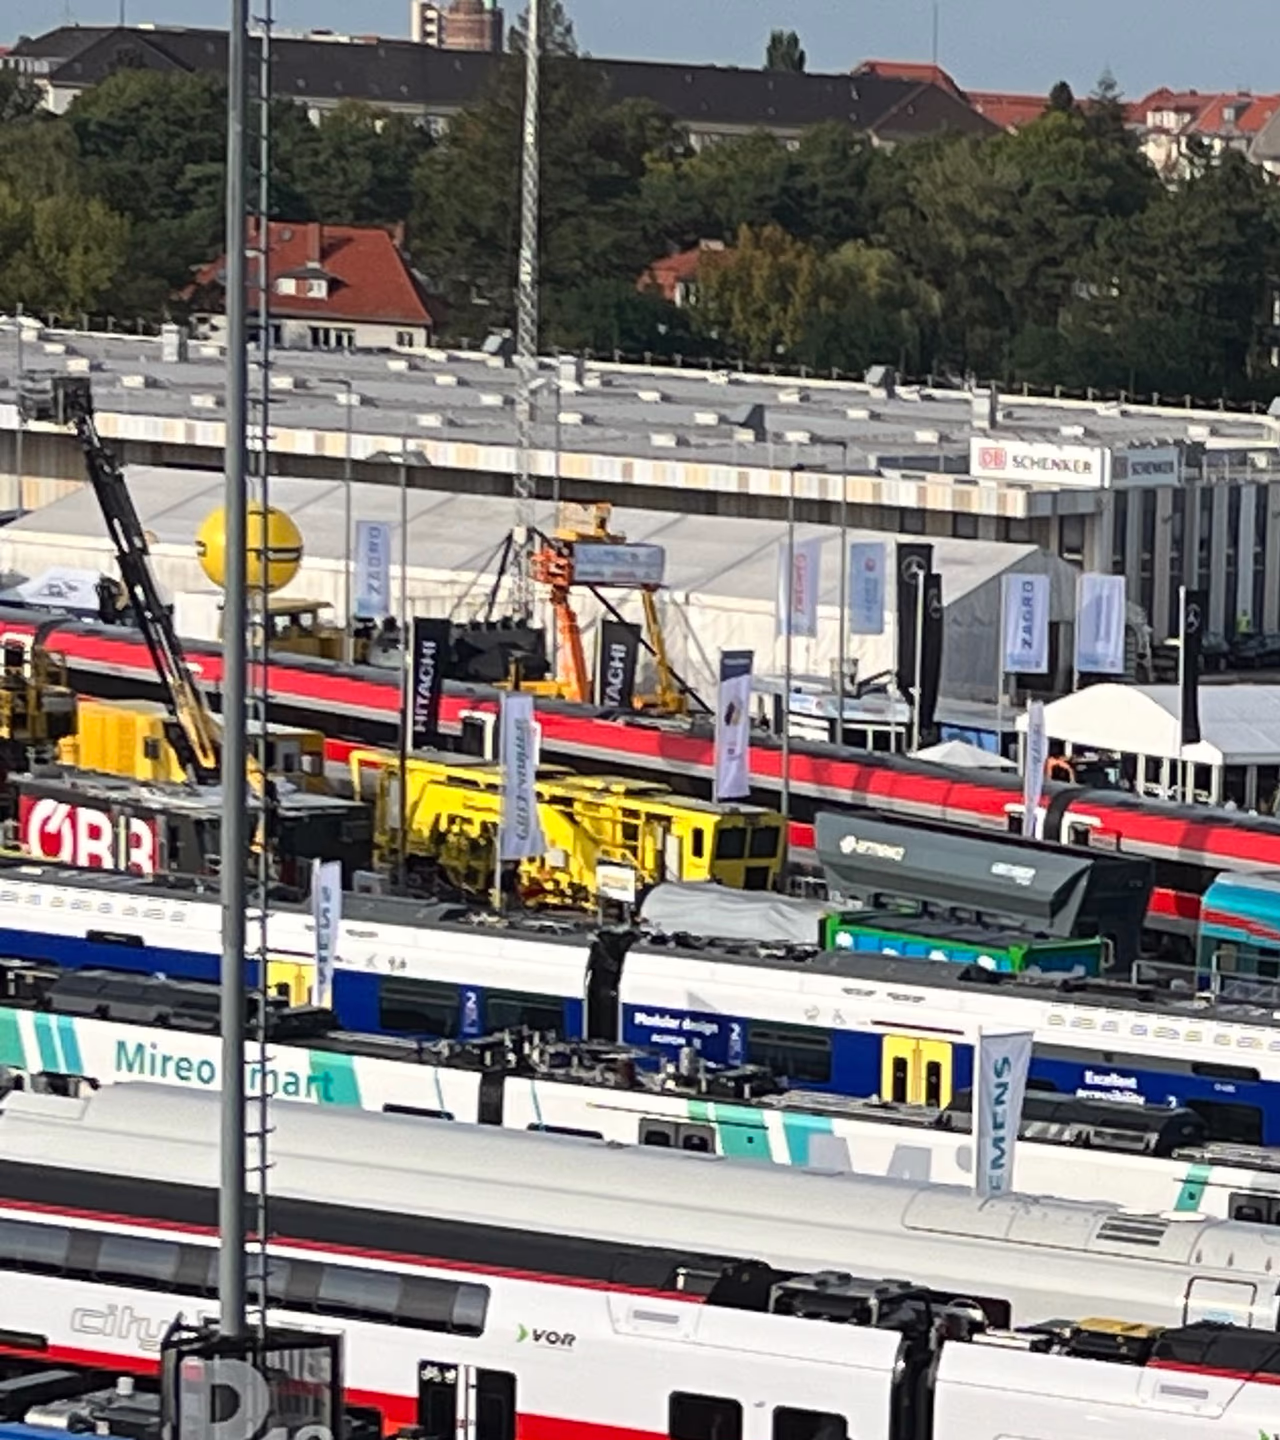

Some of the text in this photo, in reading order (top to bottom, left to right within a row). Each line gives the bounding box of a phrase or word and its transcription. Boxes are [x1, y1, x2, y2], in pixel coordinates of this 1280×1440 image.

[1012, 453, 1093, 476] SCHENKER
[1021, 580, 1035, 651] ZAGRO
[413, 639, 438, 733] HITACHI
[114, 1039, 217, 1085] Mireo
[532, 1326, 577, 1348] VOR
